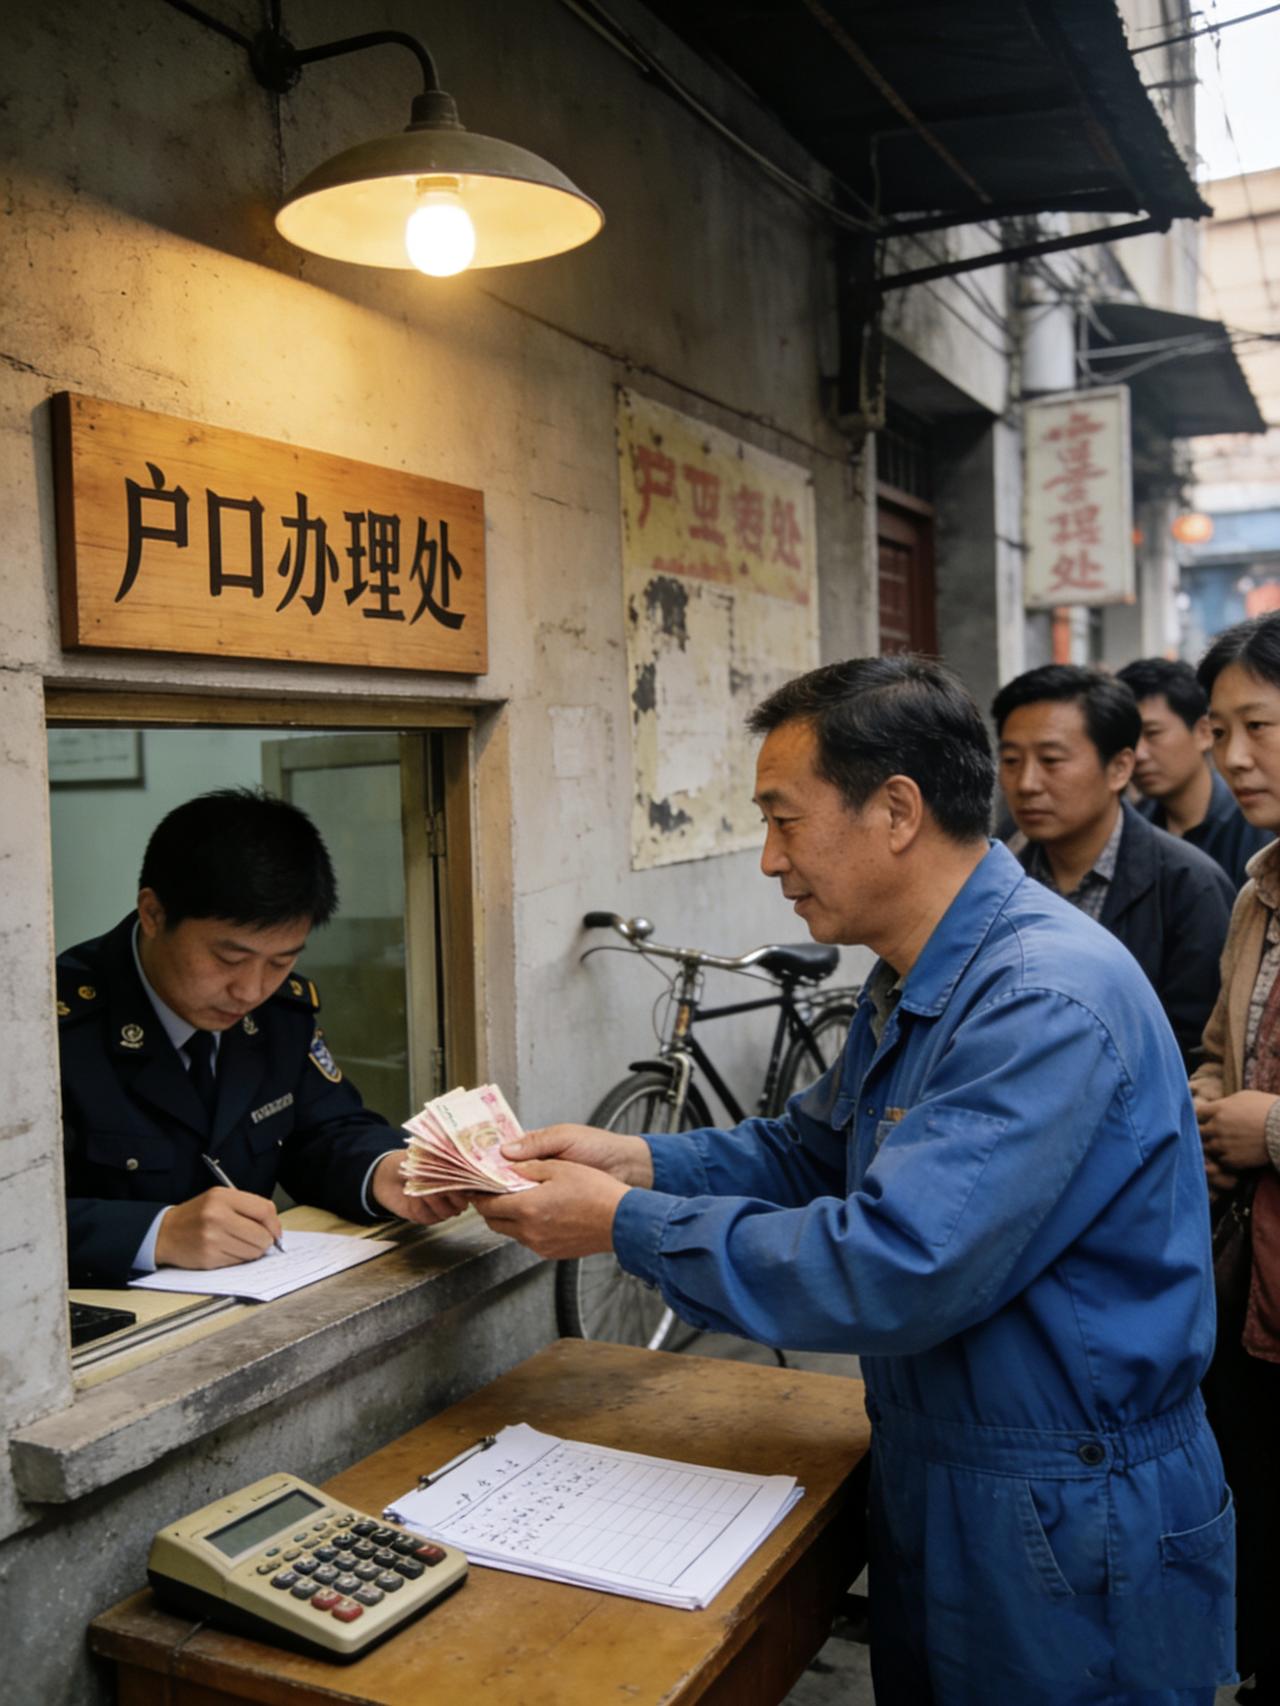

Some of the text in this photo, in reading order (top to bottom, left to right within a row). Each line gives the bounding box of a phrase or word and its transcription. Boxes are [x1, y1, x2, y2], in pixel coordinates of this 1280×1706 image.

[115, 461, 466, 630] 户口办理处
